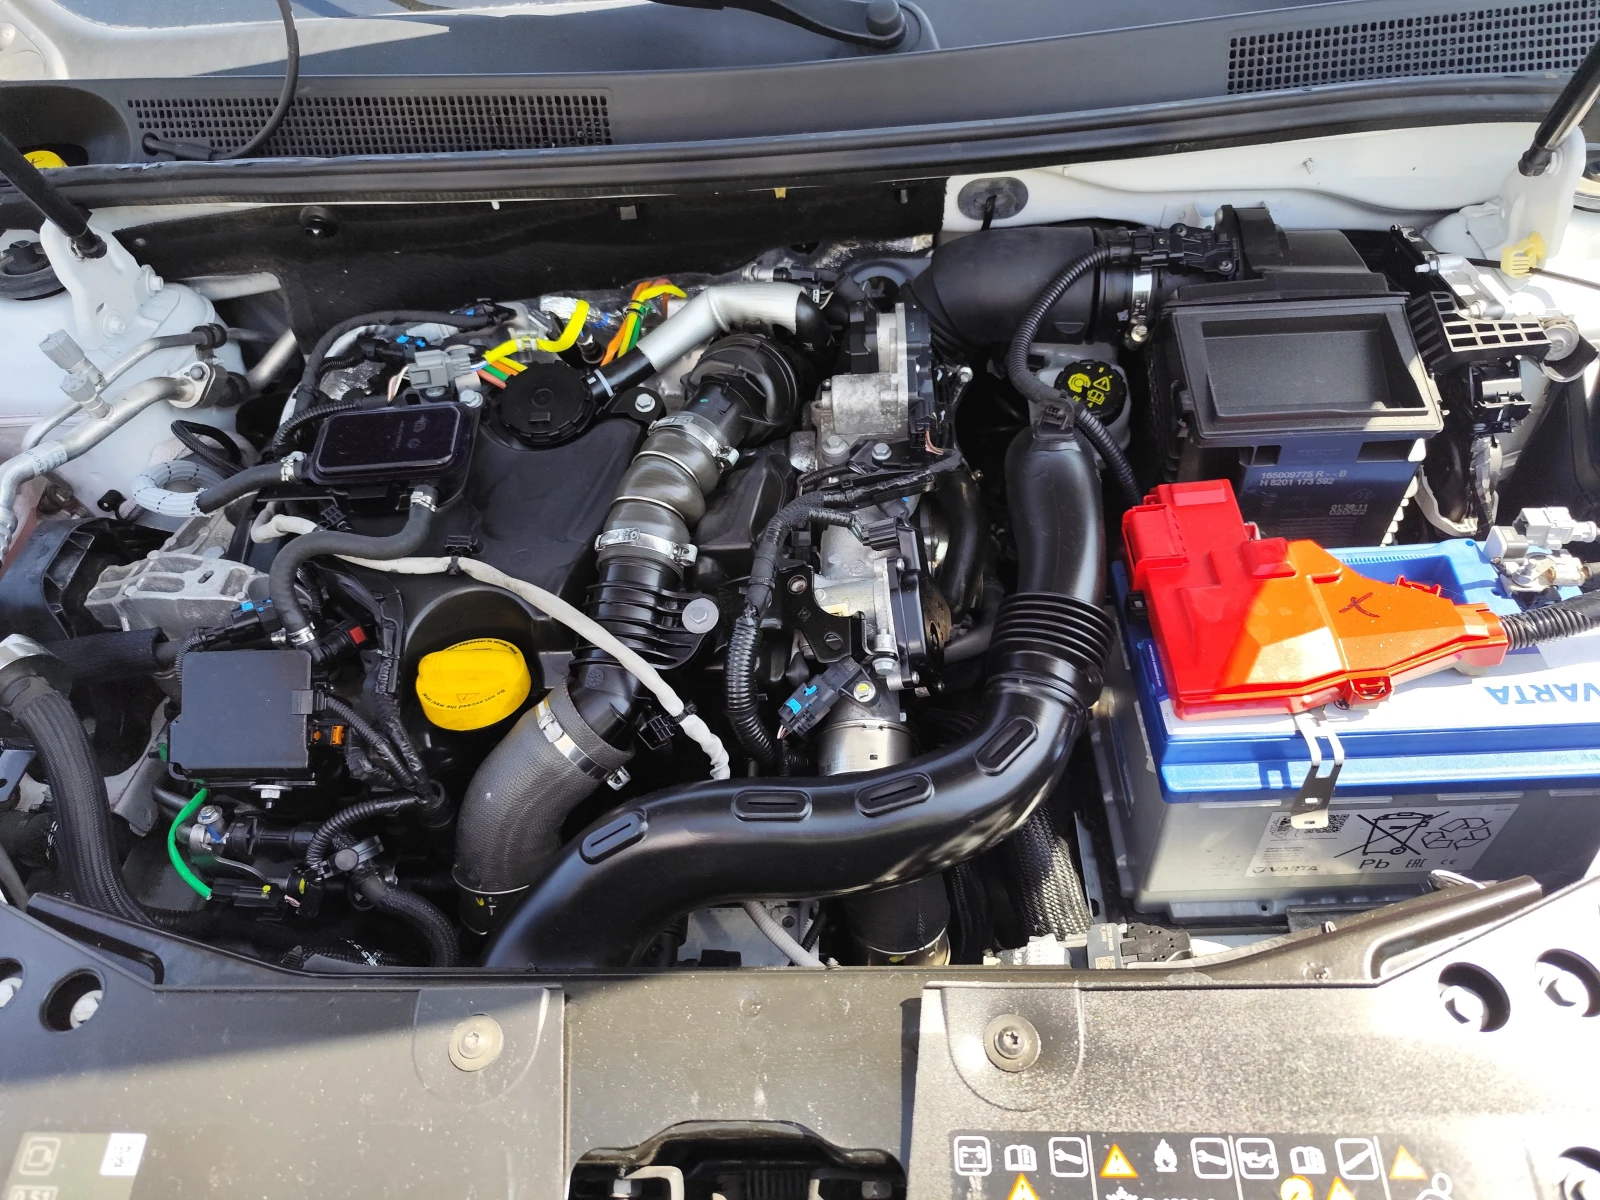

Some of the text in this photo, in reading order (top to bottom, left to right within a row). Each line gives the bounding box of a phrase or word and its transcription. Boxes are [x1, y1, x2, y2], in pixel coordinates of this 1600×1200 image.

[1261, 470, 1314, 479] 165009775
[1260, 479, 1268, 487] H
[1315, 477, 1335, 485] 592
[1483, 682, 1600, 705] VARTA
[1269, 864, 1319, 873] VARTA
[1358, 859, 1390, 869] Pb
